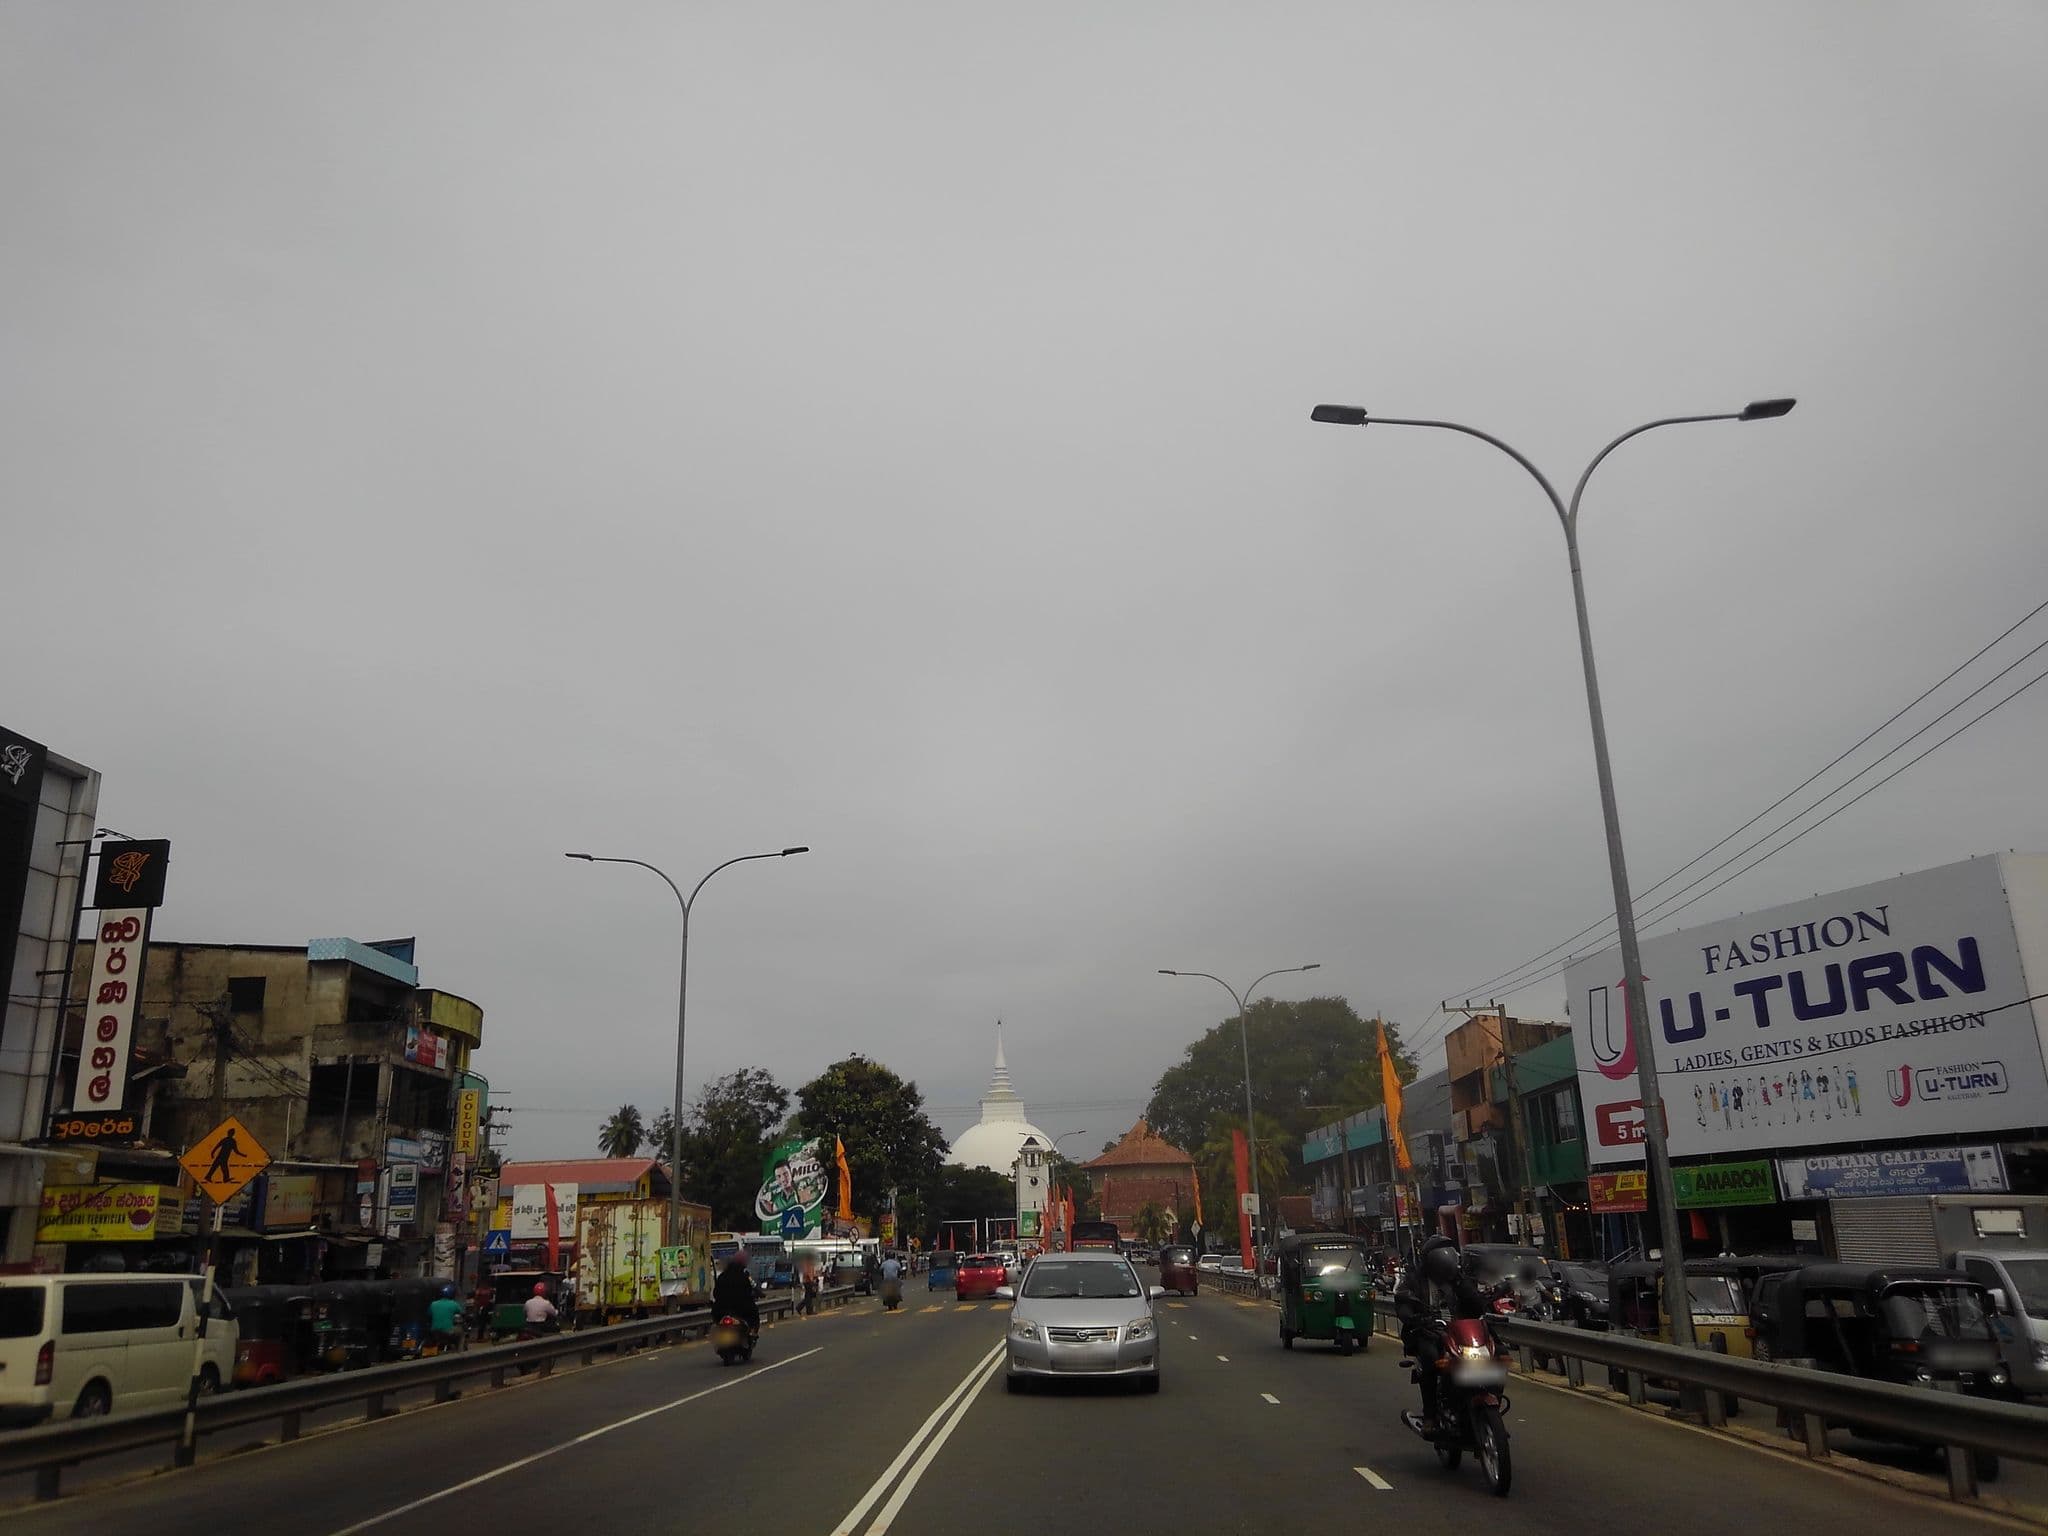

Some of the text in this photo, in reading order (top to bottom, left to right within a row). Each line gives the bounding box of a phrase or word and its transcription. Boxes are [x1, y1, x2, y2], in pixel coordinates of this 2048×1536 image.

[1702, 906, 1890, 975] FASHION
[1660, 937, 1987, 1044] U-TURN
[1674, 1010, 1986, 1073] LADIES, GENTS & KIDS FASHION
[1936, 1062, 1980, 1075] FASHION
[1925, 1072, 1998, 1093] U-TURN
[461, 1092, 474, 1149] COLOUR
[1617, 1125, 1628, 1140] 5
[791, 1163, 820, 1178] MILO
[1806, 1149, 1963, 1171] CURTAIN GALLERY
[1695, 1167, 1768, 1192] AMARON
